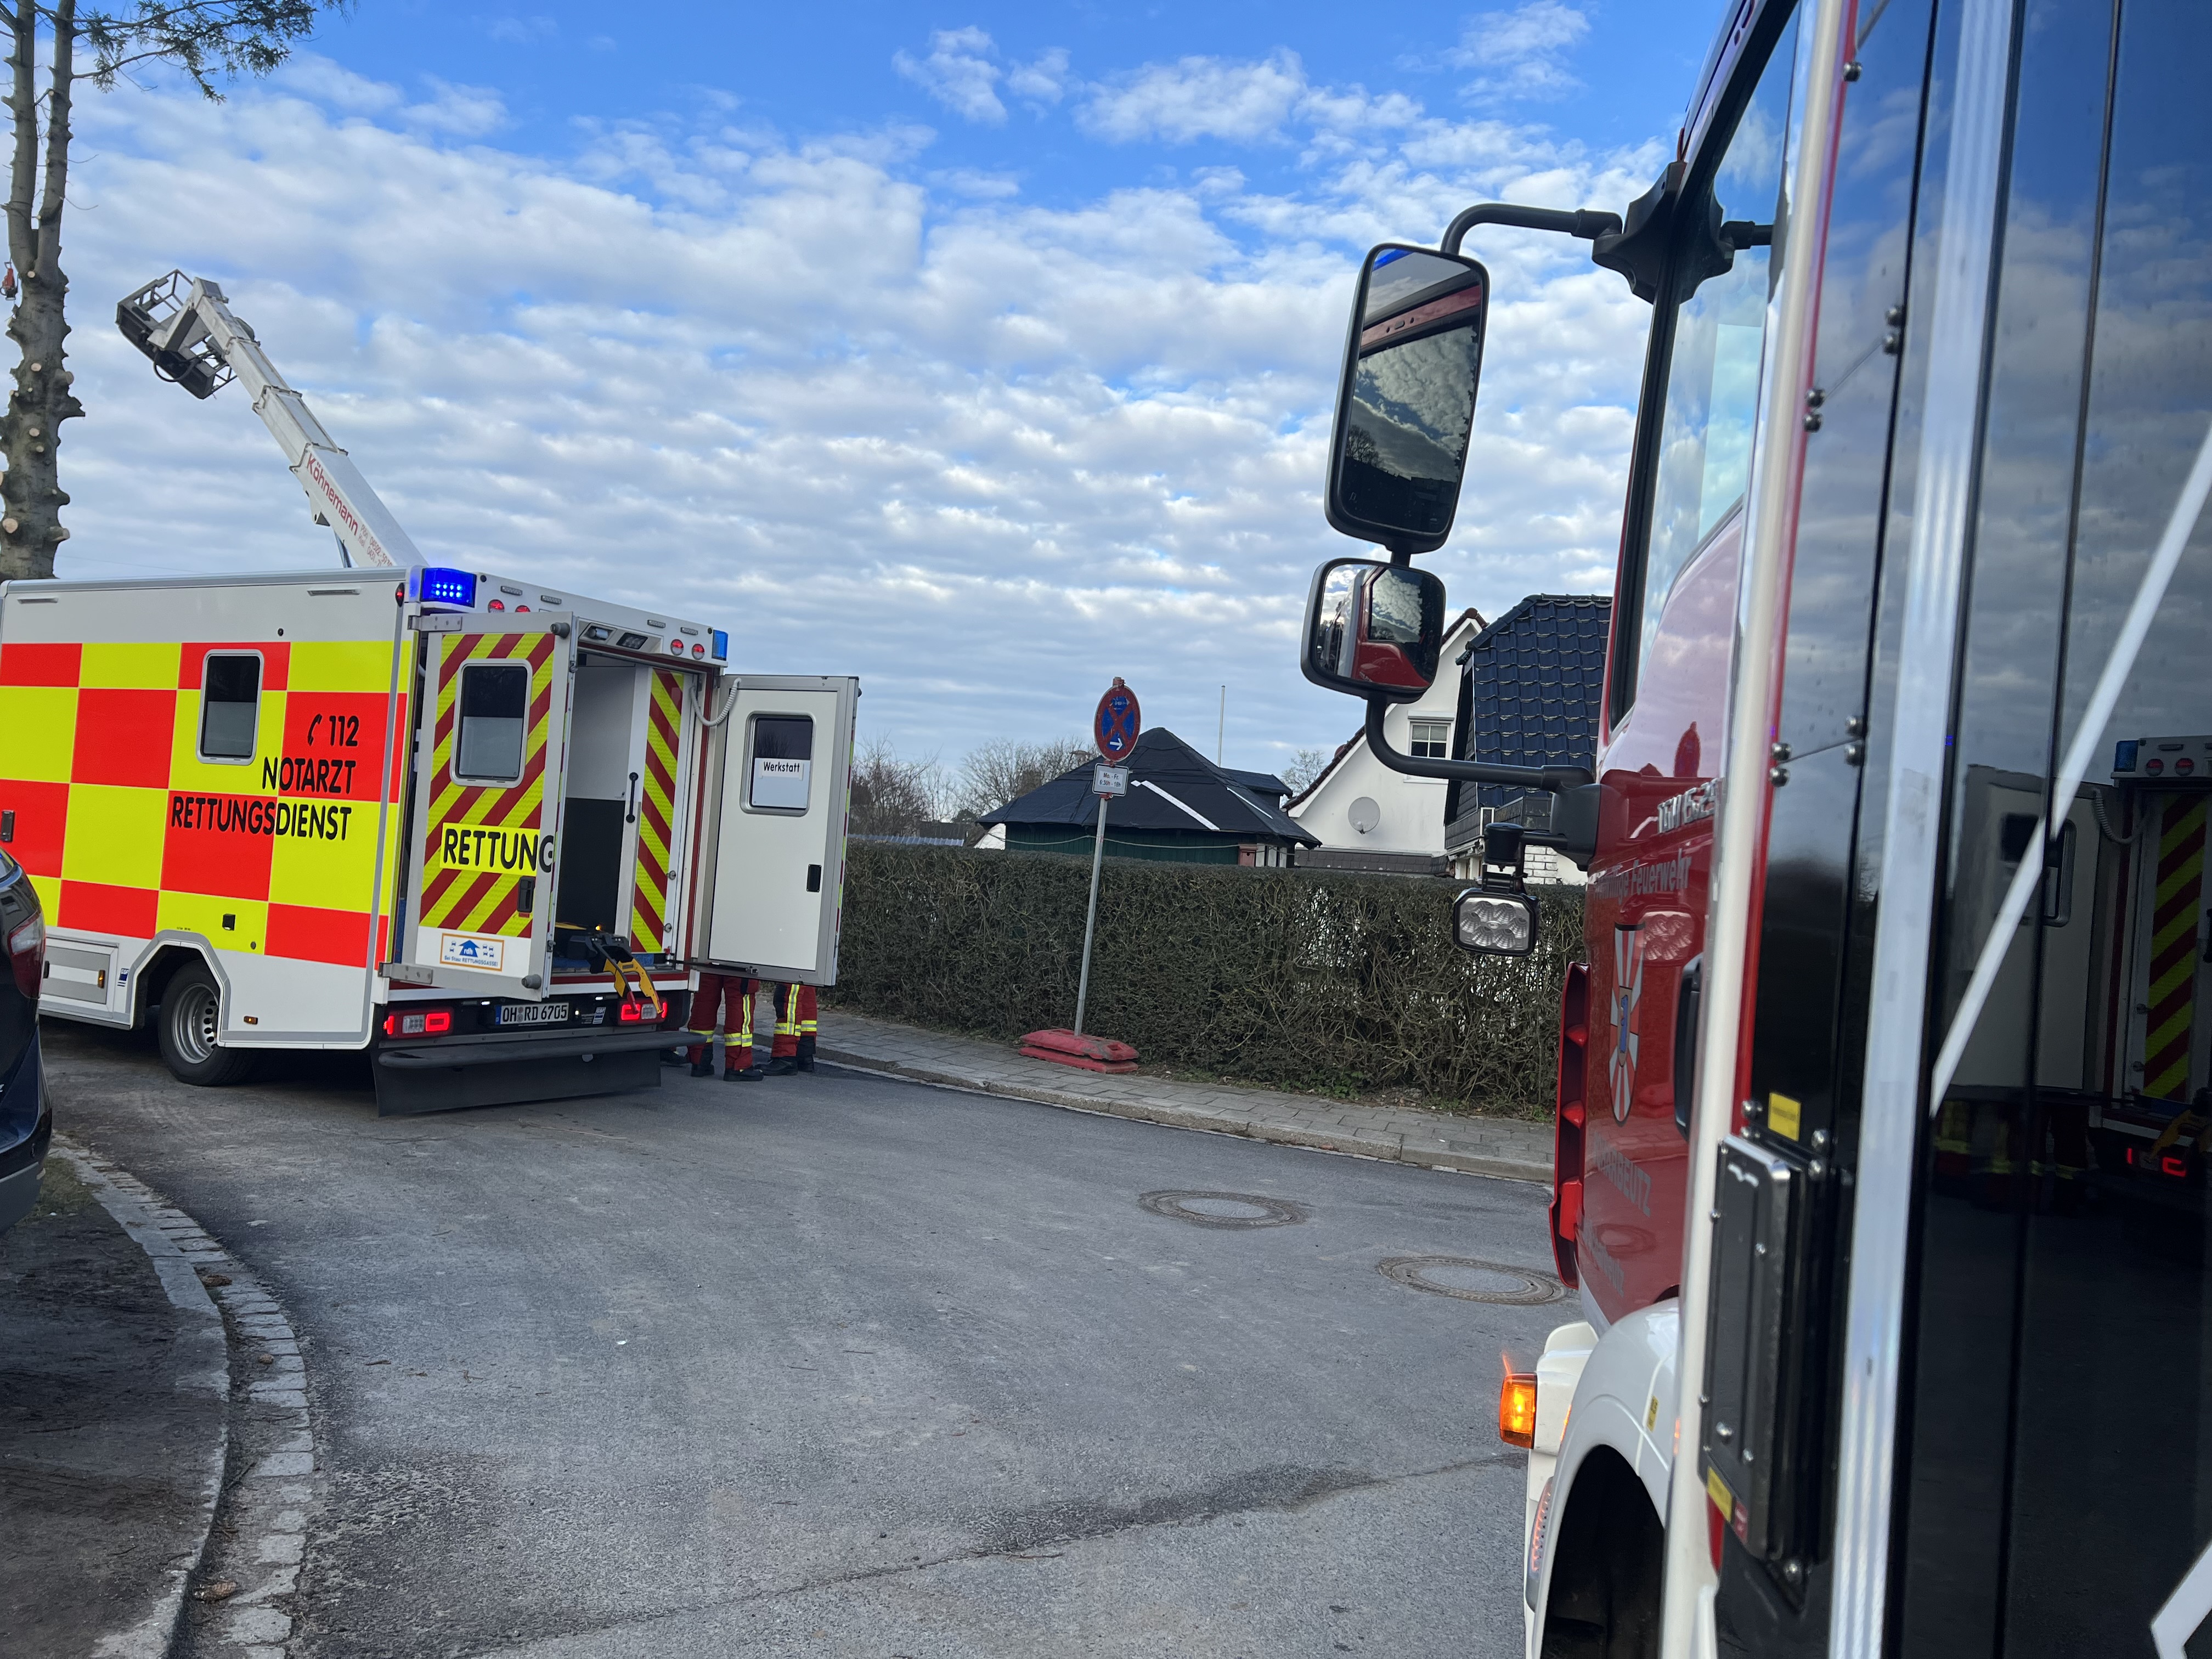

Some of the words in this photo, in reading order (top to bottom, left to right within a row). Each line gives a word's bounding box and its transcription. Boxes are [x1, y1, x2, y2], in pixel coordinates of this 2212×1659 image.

[307, 453, 358, 536] Köhnemann
[329, 715, 359, 747] 112
[262, 757, 356, 794] NOTARZT
[763, 761, 800, 772] Werkstatt
[171, 796, 352, 841] RETTUNGSDIENST
[443, 828, 554, 873] RETTUNG
[1632, 848, 1692, 896] Feuerwehr
[503, 1007, 517, 1023] OH
[524, 1007, 538, 1021] RD
[541, 1005, 567, 1020] 6705
